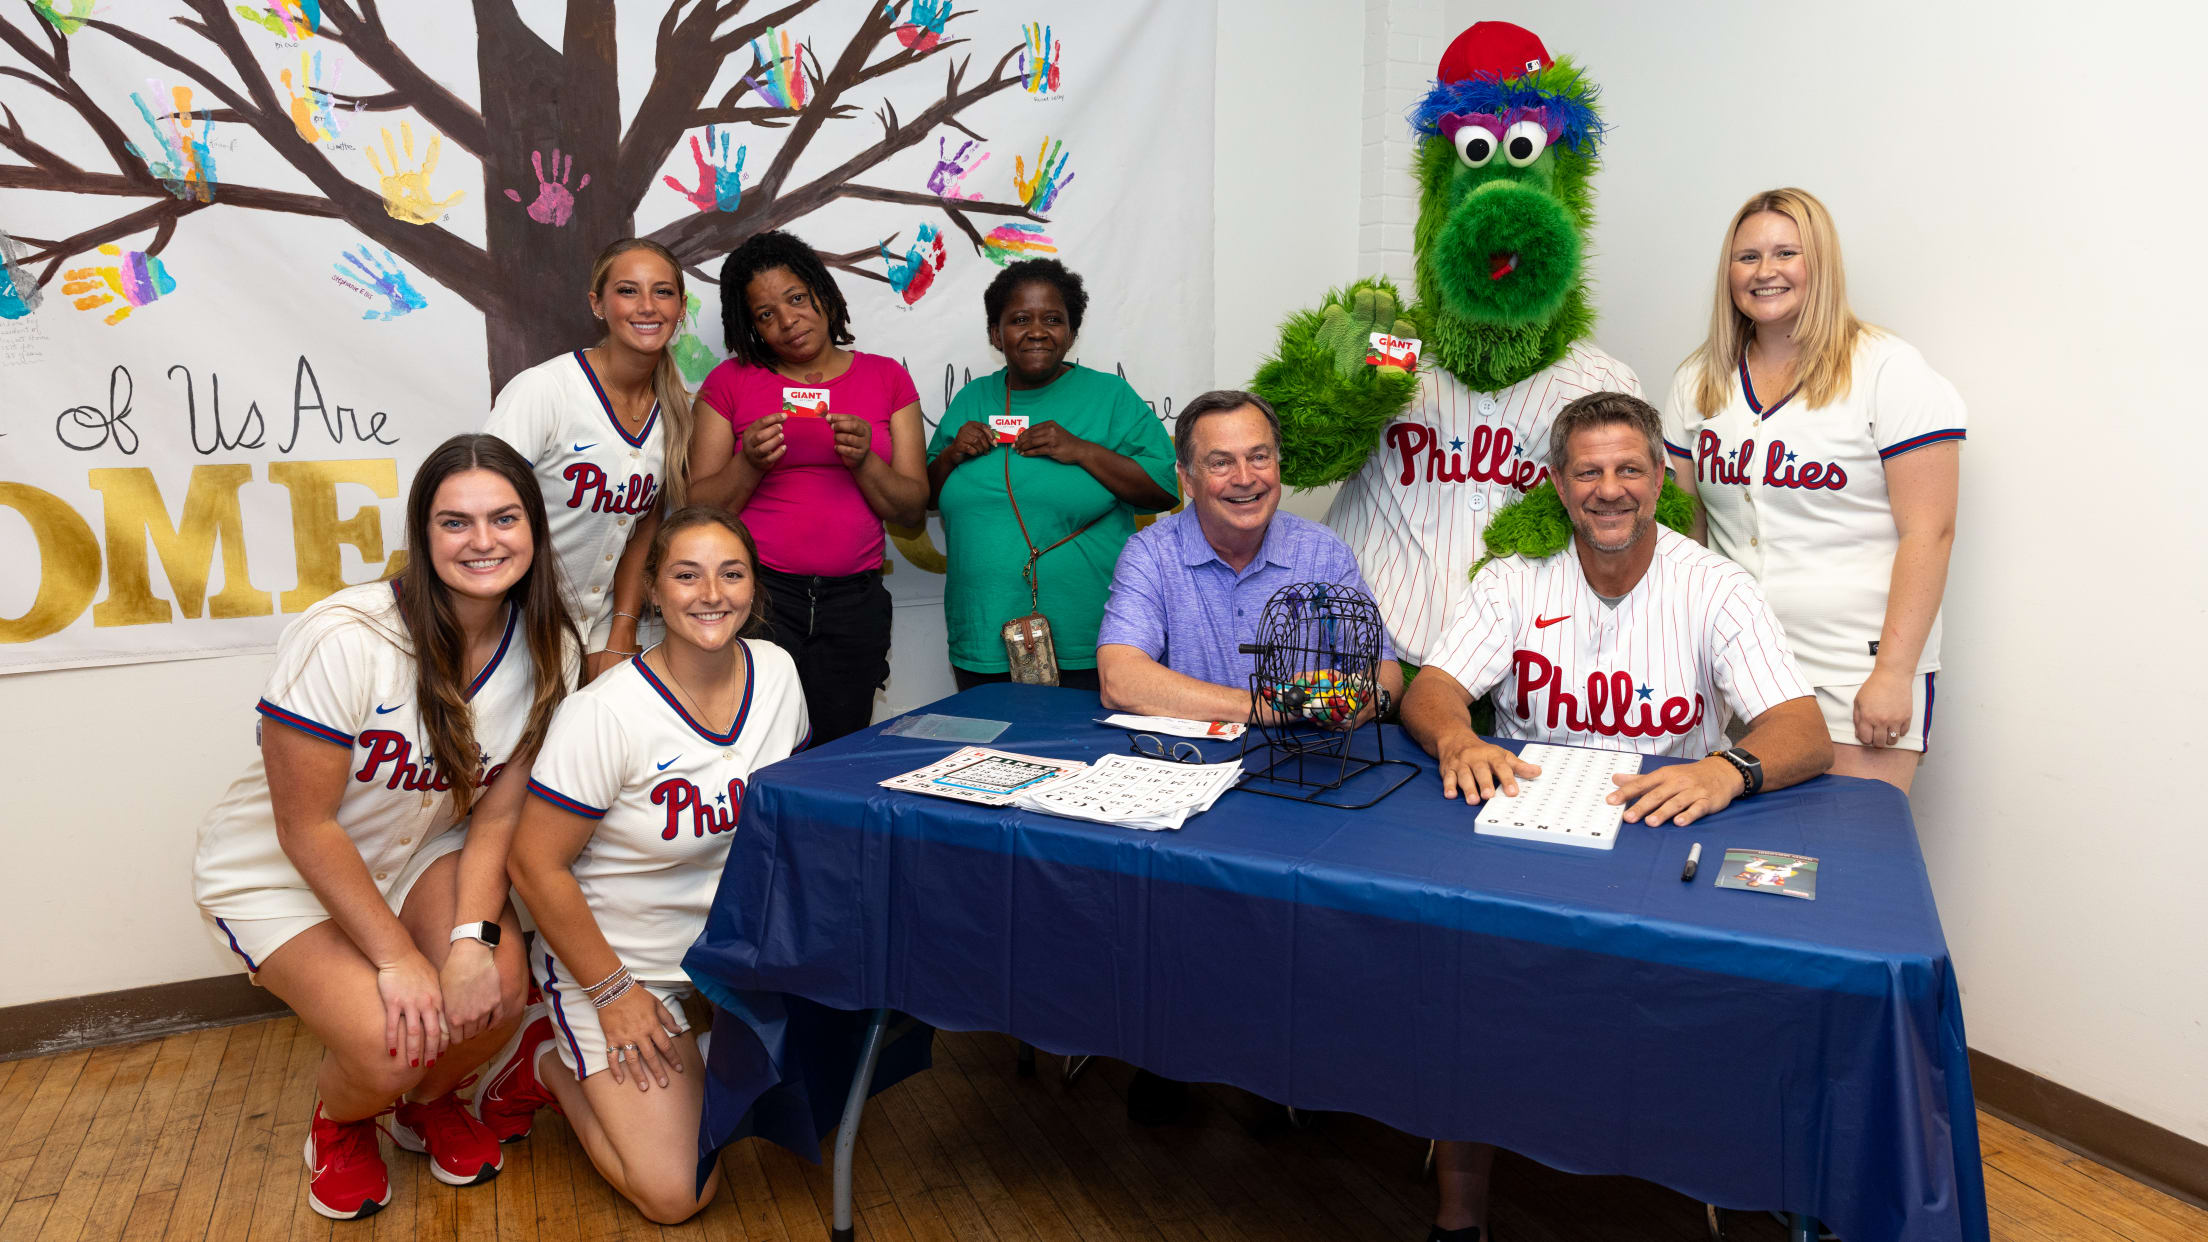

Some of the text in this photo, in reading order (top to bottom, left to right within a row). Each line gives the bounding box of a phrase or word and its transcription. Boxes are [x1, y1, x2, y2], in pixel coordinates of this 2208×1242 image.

[1378, 337, 1413, 350] GANT
[56, 354, 400, 455] of Us Are
[791, 391, 823, 400] GIANT
[995, 418, 1023, 426] GIANT
[562, 462, 658, 515] Philli
[650, 777, 746, 841] Phil
